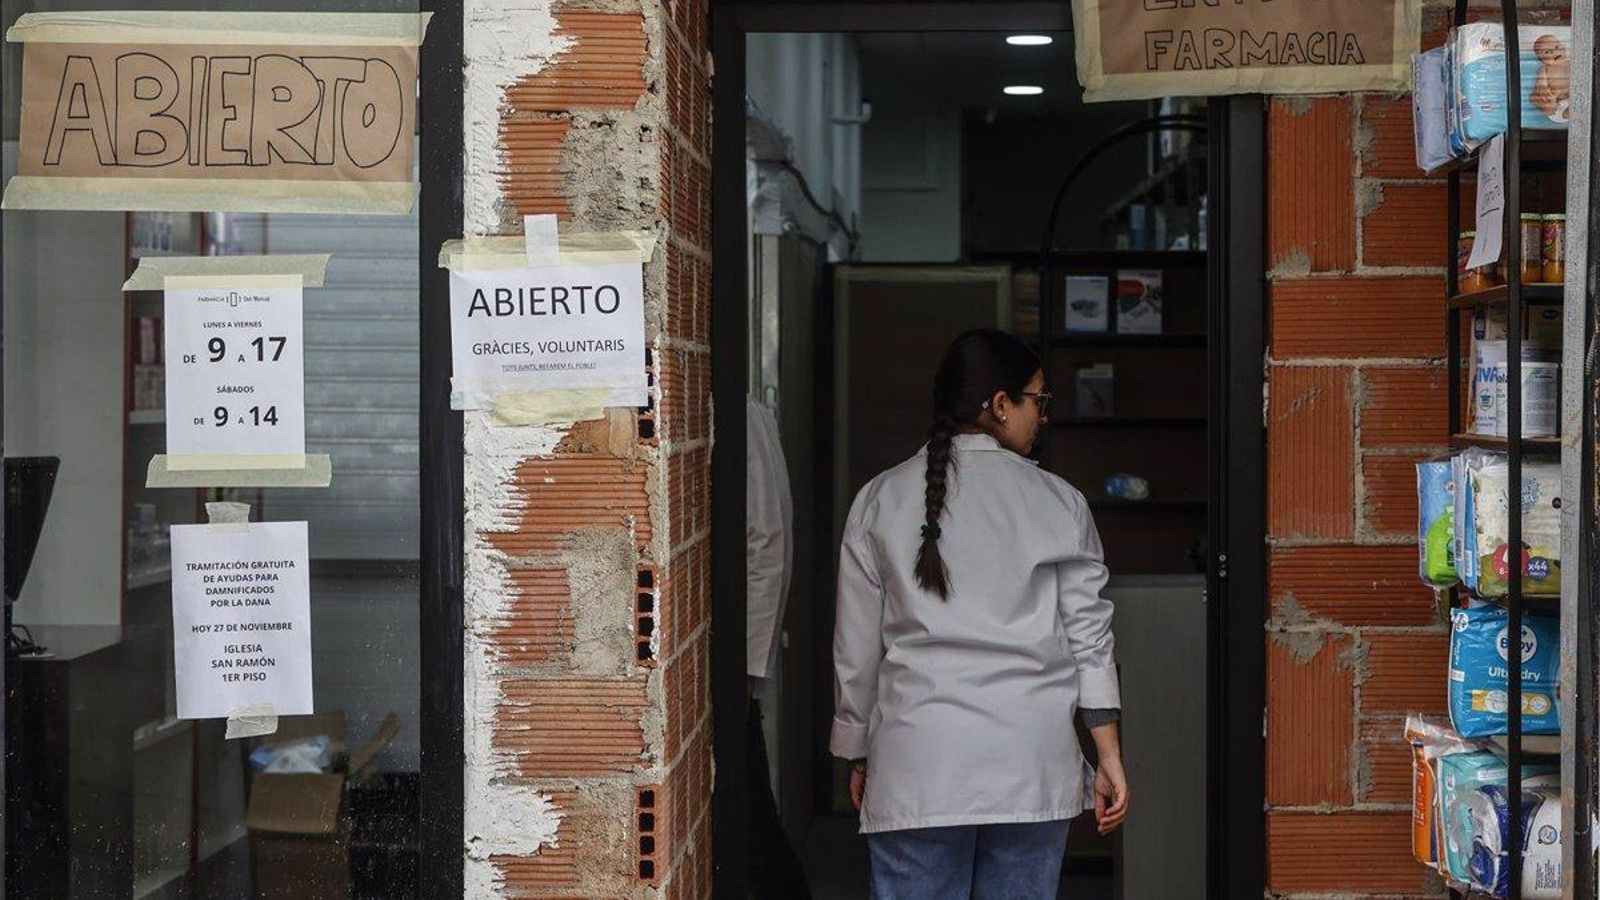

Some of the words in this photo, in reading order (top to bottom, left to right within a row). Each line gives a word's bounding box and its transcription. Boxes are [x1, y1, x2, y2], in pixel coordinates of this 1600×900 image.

[1144, 28, 1365, 70] FARMACIA
[43, 52, 403, 169] ABIERTO
[467, 285, 620, 318] ABIERTO
[183, 355, 197, 363] DE
[208, 337, 226, 363] 9
[238, 354, 246, 362] A
[251, 336, 287, 362] 17
[472, 340, 534, 356] GRÀCIES,
[538, 339, 625, 354] VOLUNTARIS
[216, 385, 255, 394] SÁBADOS
[193, 417, 205, 425] DE
[214, 406, 229, 427] 9
[249, 406, 278, 426] 14
[186, 561, 249, 571] TRAMITACIÓN
[251, 560, 295, 569] GRATUITA
[203, 575, 217, 583] DE
[217, 574, 253, 582] AYUDAS
[255, 573, 279, 581] PARA
[206, 586, 275, 595] DAMNIFICADOS
[245, 598, 271, 606] DANA
[192, 625, 212, 633] HOY
[213, 624, 224, 632] 27
[240, 622, 293, 631] NOVIEMBRE
[224, 644, 263, 653] IGLESIA
[211, 659, 233, 668] SAN
[236, 657, 275, 667] RAMÓN
[222, 673, 240, 682] 1ER
[243, 672, 267, 681] PISO
